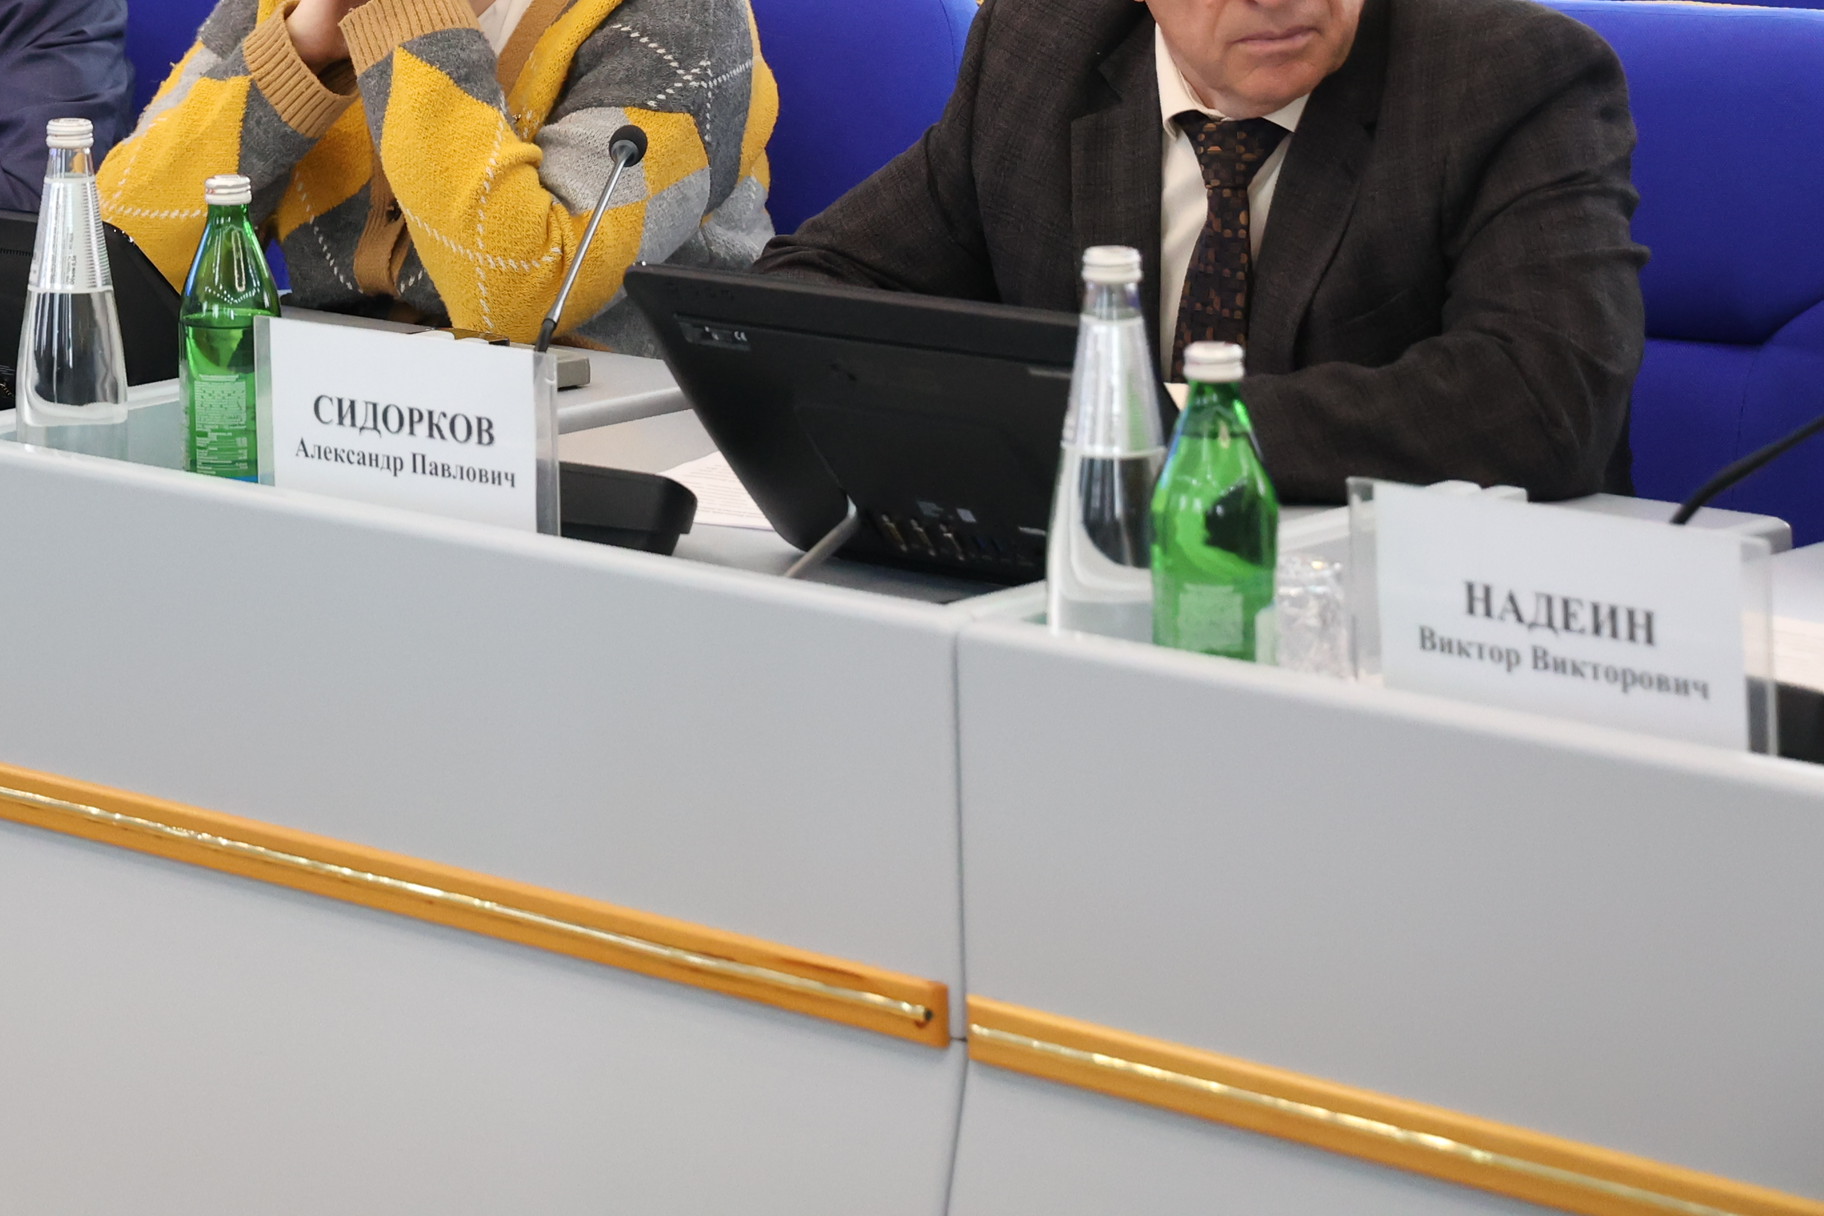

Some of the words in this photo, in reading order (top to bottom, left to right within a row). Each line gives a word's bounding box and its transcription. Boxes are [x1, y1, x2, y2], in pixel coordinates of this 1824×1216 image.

[312, 394, 497, 447] СИДОРКОВ
[295, 436, 405, 478] Александр
[411, 452, 517, 489] Павлович
[1463, 580, 1657, 648] НАДЕИН
[1417, 625, 1522, 674] Виктор
[1530, 646, 1711, 702] Викторович
